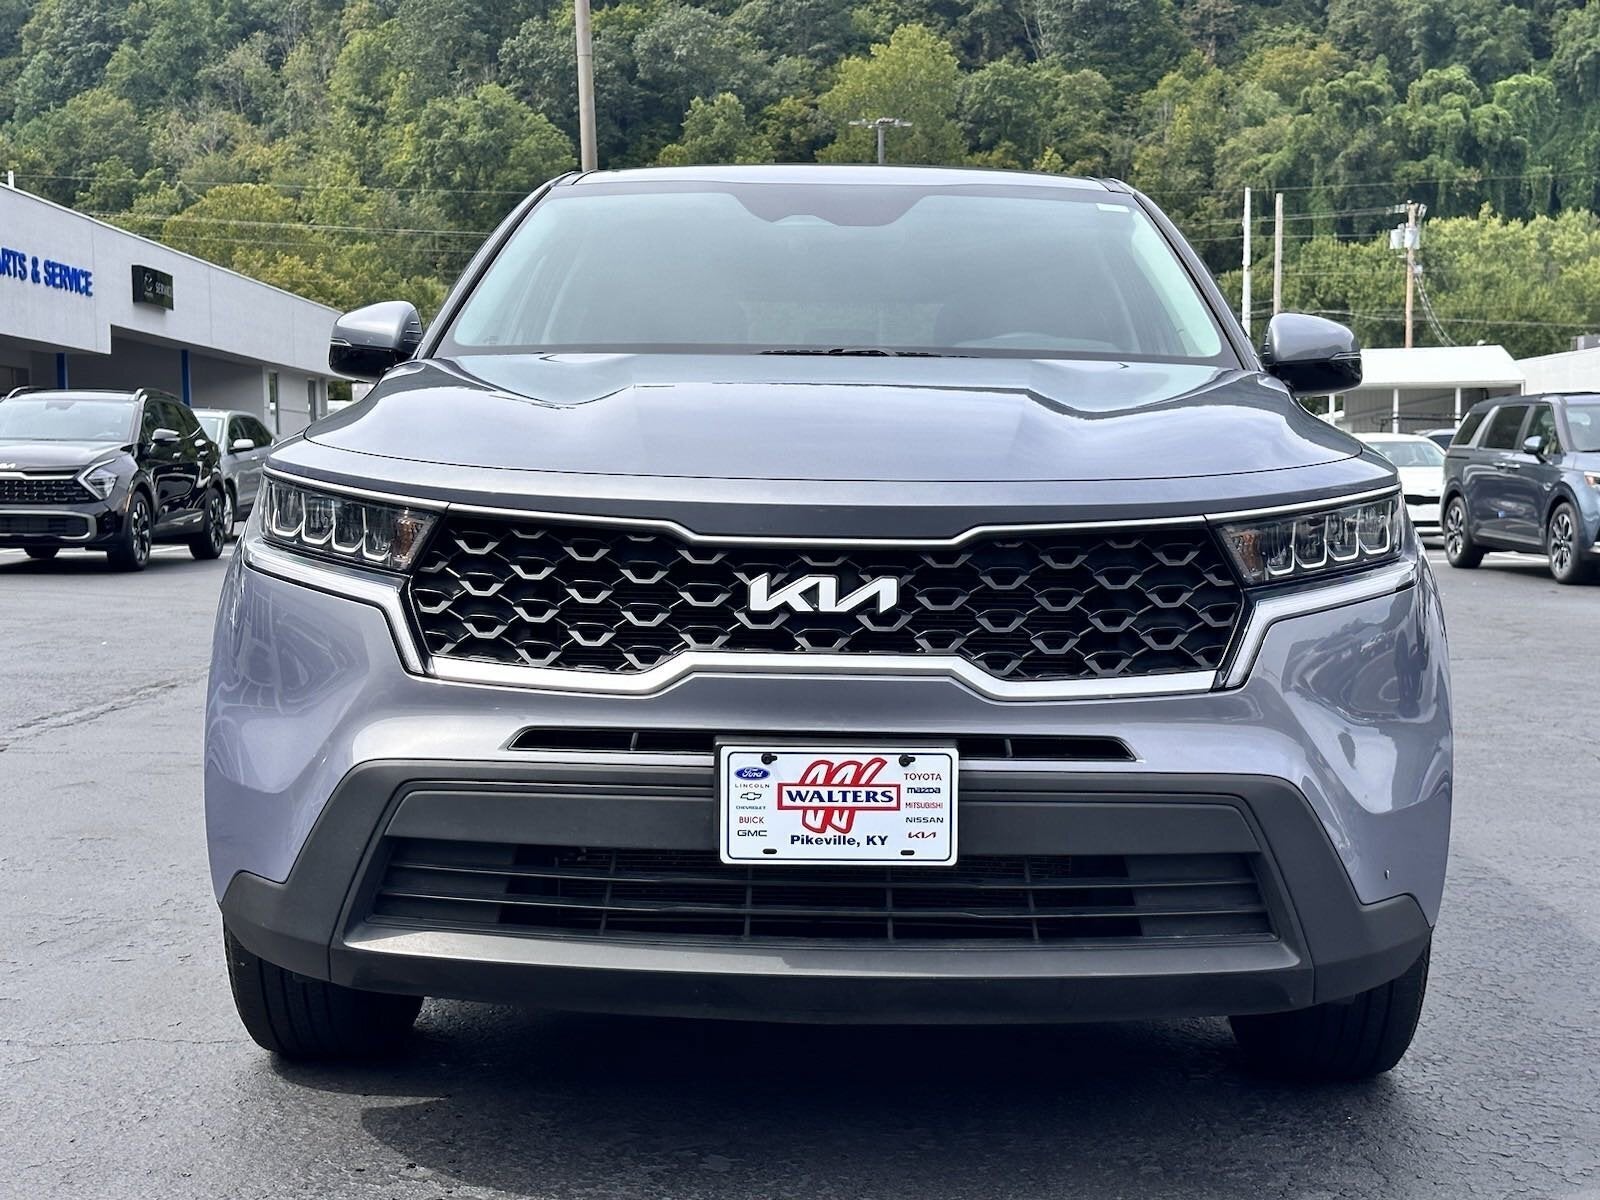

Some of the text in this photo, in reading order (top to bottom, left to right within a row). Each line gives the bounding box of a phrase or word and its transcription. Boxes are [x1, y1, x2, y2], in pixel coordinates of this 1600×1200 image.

[0, 246, 93, 297] RTS & SERVICE
[748, 573, 900, 615] KIA
[786, 790, 894, 803] WALTERS
[739, 816, 765, 824] BUICK
[737, 829, 767, 837] GMC
[790, 835, 888, 847] Pikeville, KY
